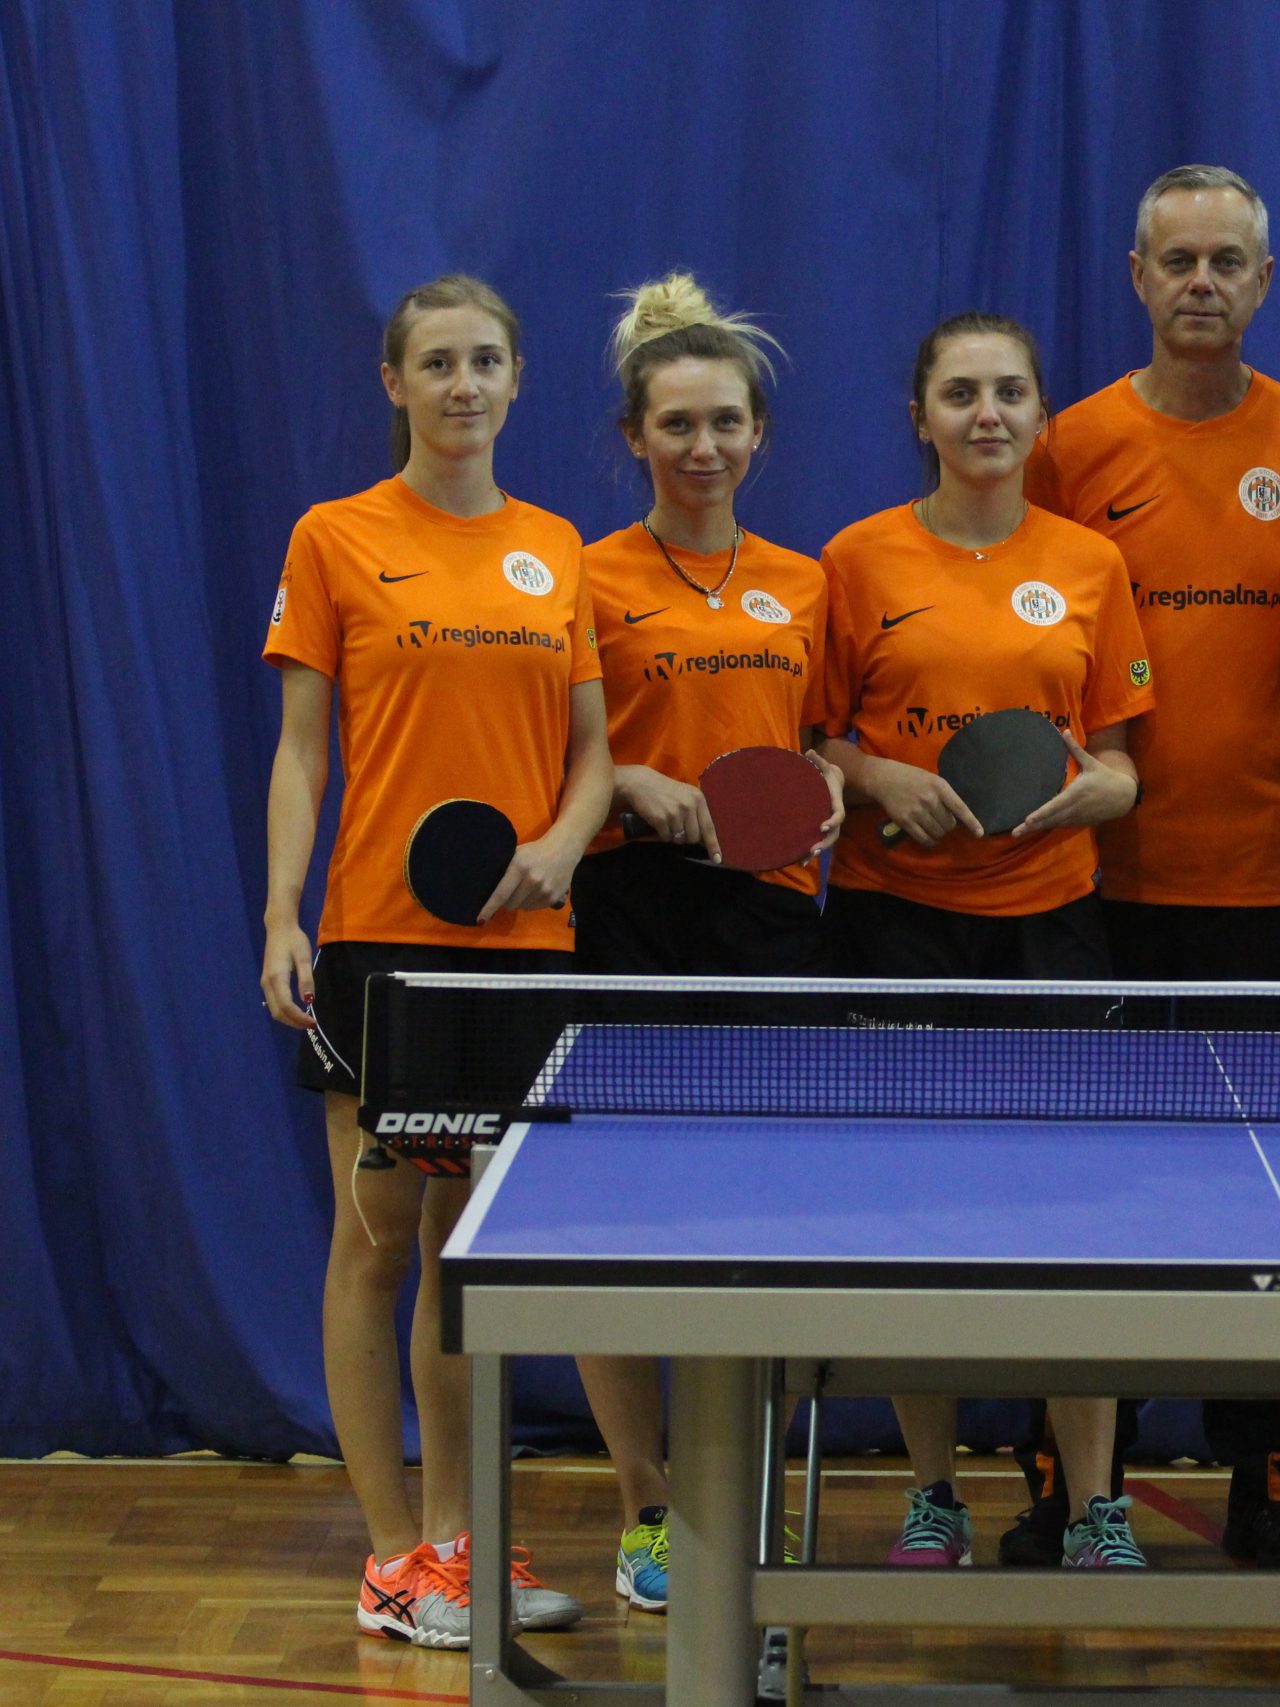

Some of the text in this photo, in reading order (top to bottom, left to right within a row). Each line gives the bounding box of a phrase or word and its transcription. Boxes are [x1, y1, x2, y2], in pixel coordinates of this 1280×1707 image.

[441, 624, 565, 654] regionalna.pl
[686, 648, 803, 678] regionalna.pl
[375, 1112, 501, 1135] DONIC
